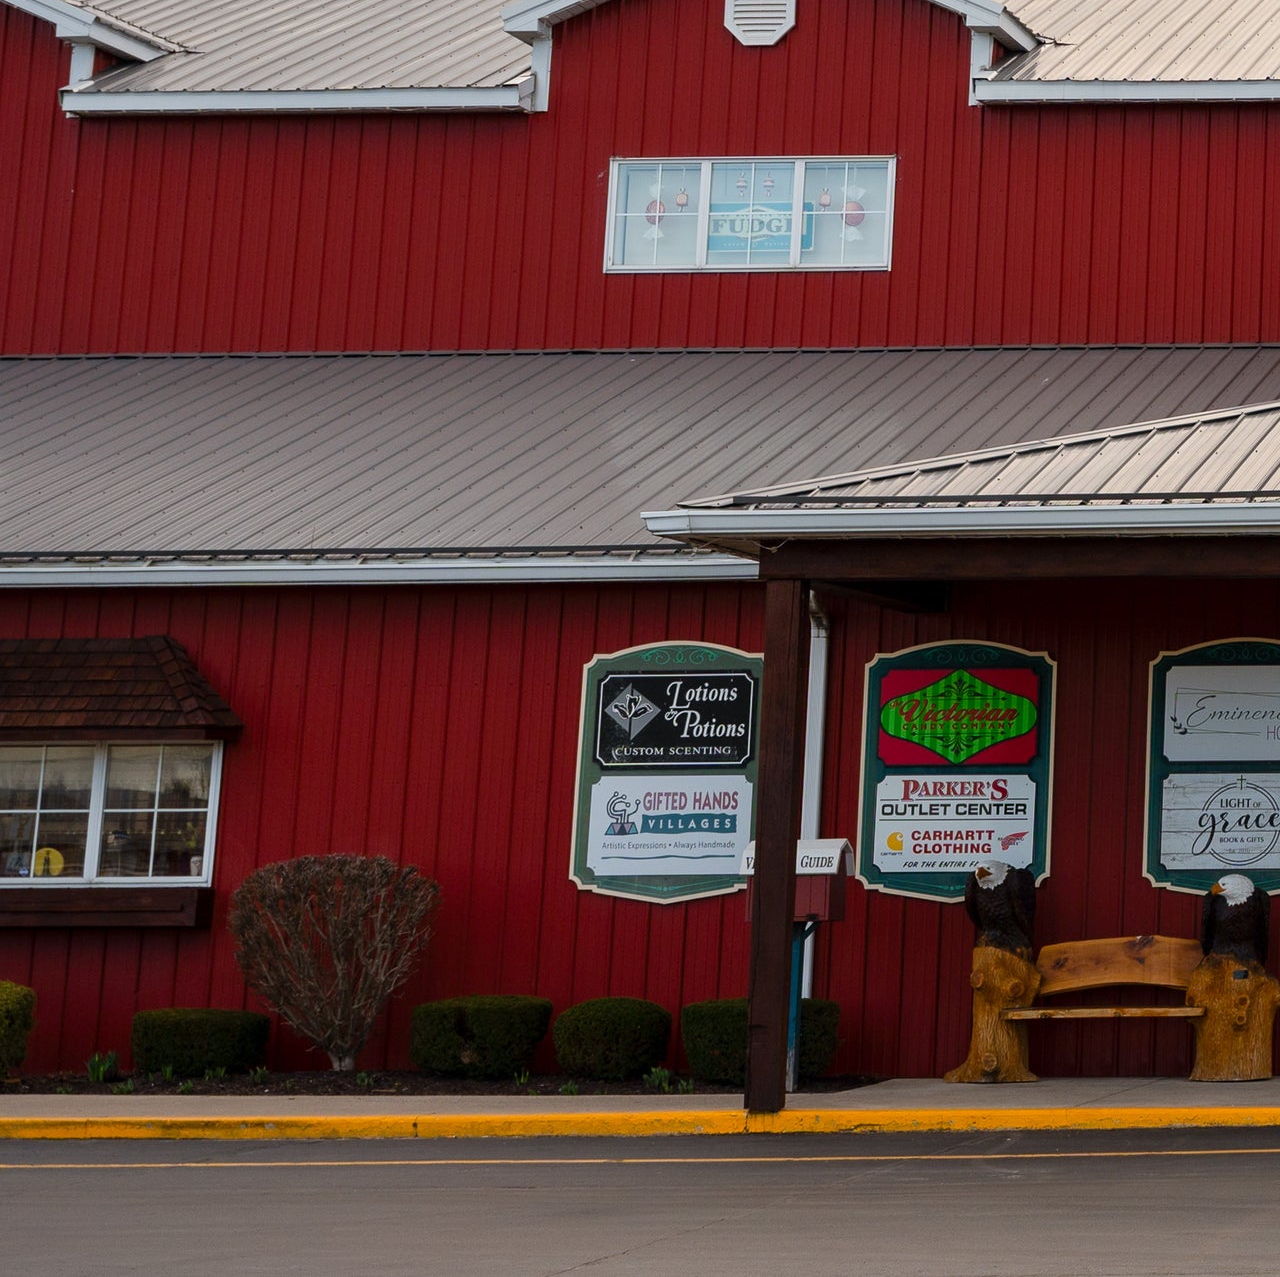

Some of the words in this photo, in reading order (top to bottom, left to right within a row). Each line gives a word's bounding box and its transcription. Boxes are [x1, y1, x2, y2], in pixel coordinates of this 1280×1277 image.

[666, 681, 737, 709] Lotions
[899, 699, 1020, 722] Victorian
[673, 710, 745, 738] Potions
[952, 722, 1014, 730] COMPANY
[615, 747, 664, 756] CUSTOM
[670, 746, 731, 755] SCENTING
[902, 779, 1008, 802] PARKER'S
[643, 792, 687, 811] GIFTED
[693, 791, 738, 810] HANDS
[1220, 798, 1252, 807] LIGHT
[882, 804, 951, 816] OUTLET
[956, 803, 1027, 815] CENTER
[648, 818, 731, 828] VILLAGES
[911, 830, 995, 840] CARHARTT
[602, 841, 626, 849] Artistic
[628, 842, 666, 850] Expressions
[674, 841, 696, 850] Always
[698, 841, 735, 849] Handmade
[913, 843, 992, 854] CLOTHING
[801, 856, 834, 868] GUIDE
